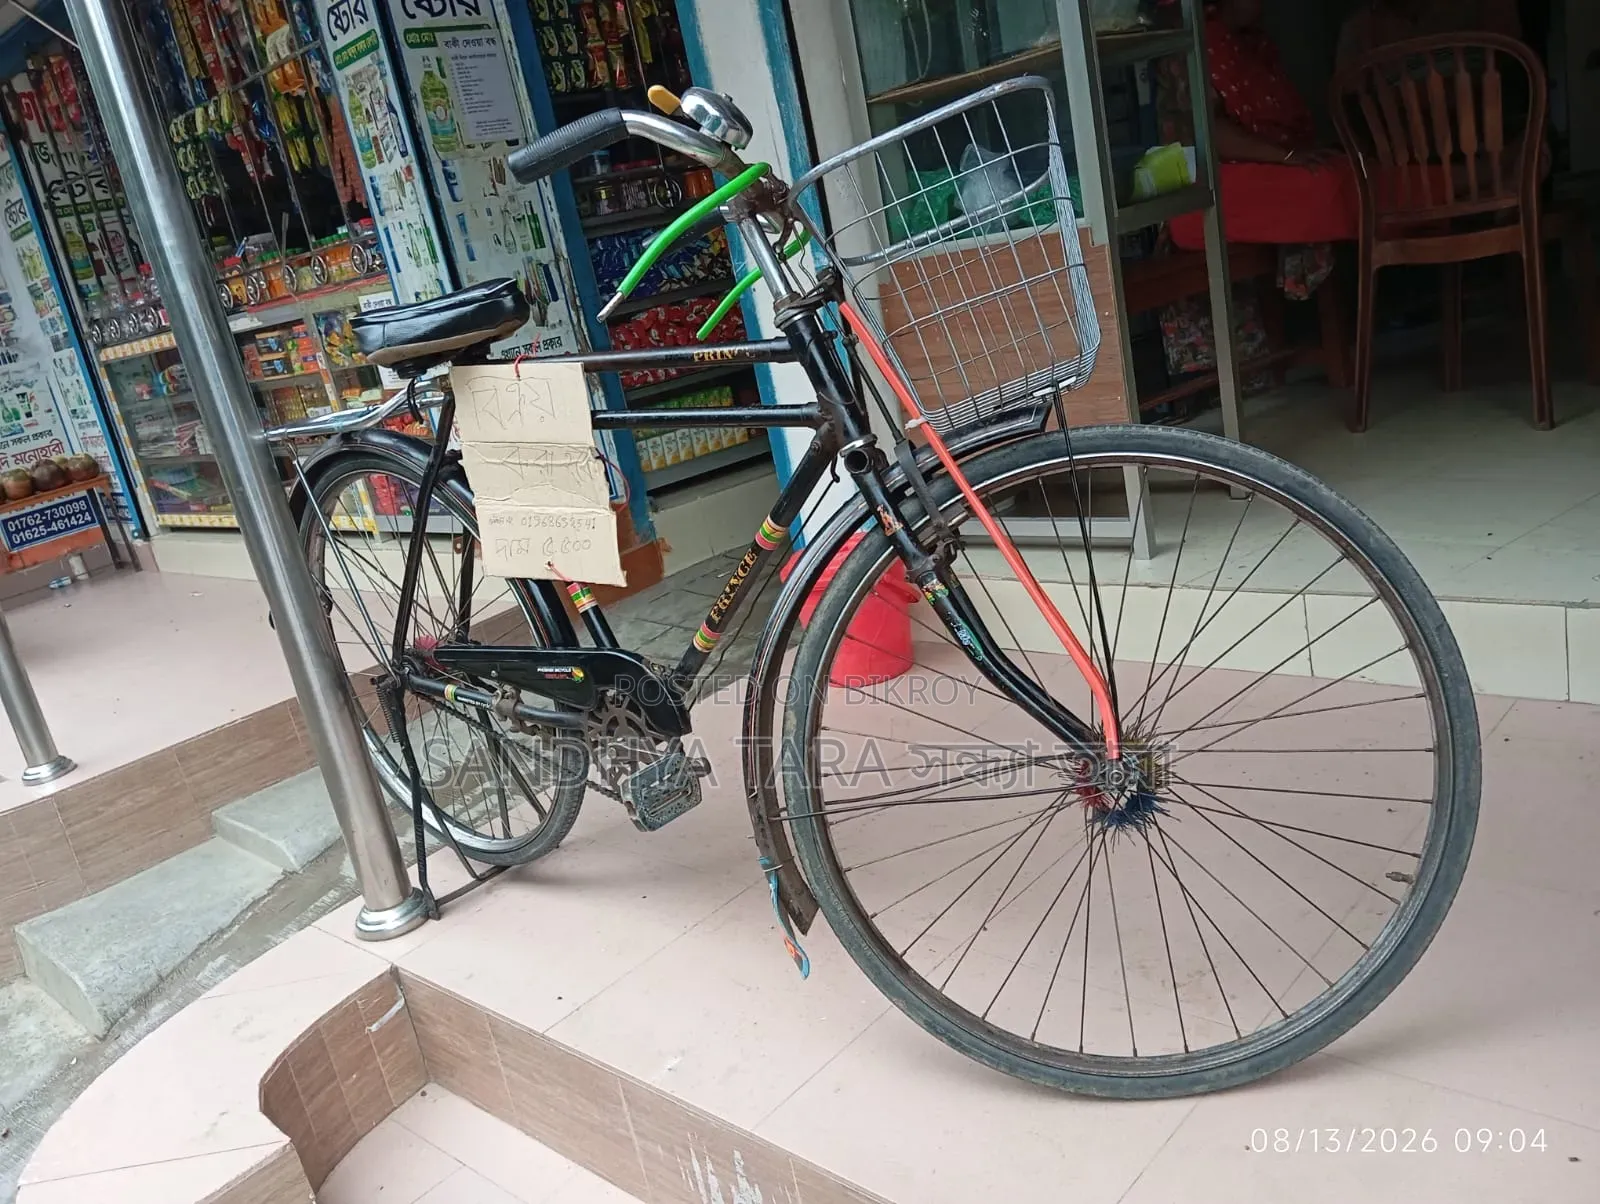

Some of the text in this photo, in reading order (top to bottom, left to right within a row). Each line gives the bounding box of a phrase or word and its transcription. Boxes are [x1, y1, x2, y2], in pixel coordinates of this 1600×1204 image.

[542, 336, 563, 350] প্রকার
[10, 434, 31, 446] সকল
[31, 429, 54, 441] প্রকার
[11, 438, 65, 466] মনোহারী
[8, 500, 88, 531] 01762-730098
[12, 512, 92, 544] 01625-461424
